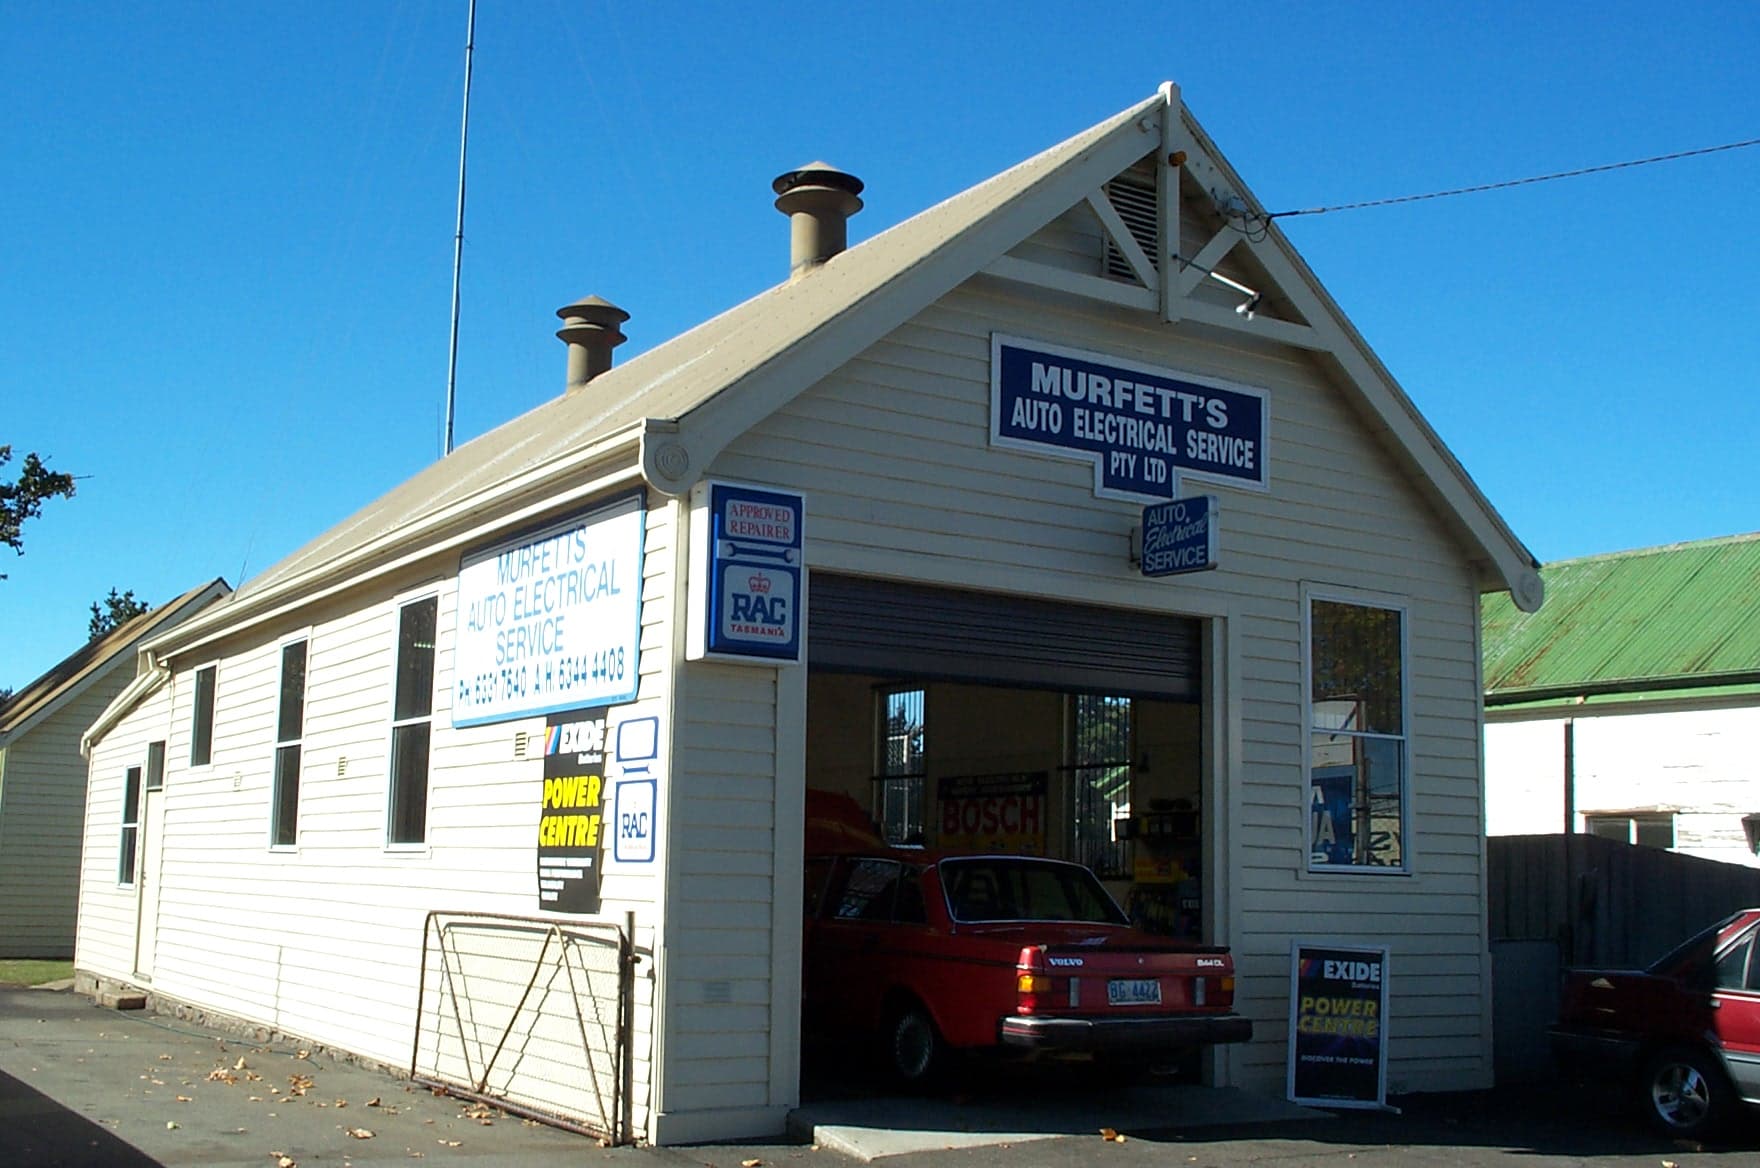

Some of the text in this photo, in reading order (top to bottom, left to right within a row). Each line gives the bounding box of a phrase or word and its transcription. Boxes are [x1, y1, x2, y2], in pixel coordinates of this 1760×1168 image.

[1032, 362, 1228, 429] MURFETT'S
[1011, 397, 1255, 470] AUTO ELECTRICAL SERVICE
[1110, 451, 1167, 484] PTY LTD
[729, 503, 790, 523] APPROVED
[1147, 503, 1187, 527] AUTO
[729, 520, 790, 540] REPAIRER
[1144, 511, 1208, 554] Electrical
[1145, 544, 1206, 572] SERVICE
[467, 558, 621, 632] AUTO ELECTRICAL
[731, 593, 786, 626] RAC
[496, 615, 565, 666] SERVICE
[730, 623, 785, 638] TASMANIA
[559, 654, 588, 690] 6344
[592, 645, 625, 684] 4408
[559, 719, 605, 755] EXIDE
[542, 775, 601, 809] POWER
[621, 812, 648, 839] RAC
[943, 794, 1040, 833] BOSCH
[539, 814, 600, 847] CENTRE
[1049, 957, 1084, 967] VOLVO
[1323, 959, 1381, 982] EXIDE
[1300, 996, 1377, 1018] POWER
[1299, 1015, 1378, 1037] CENTRE
